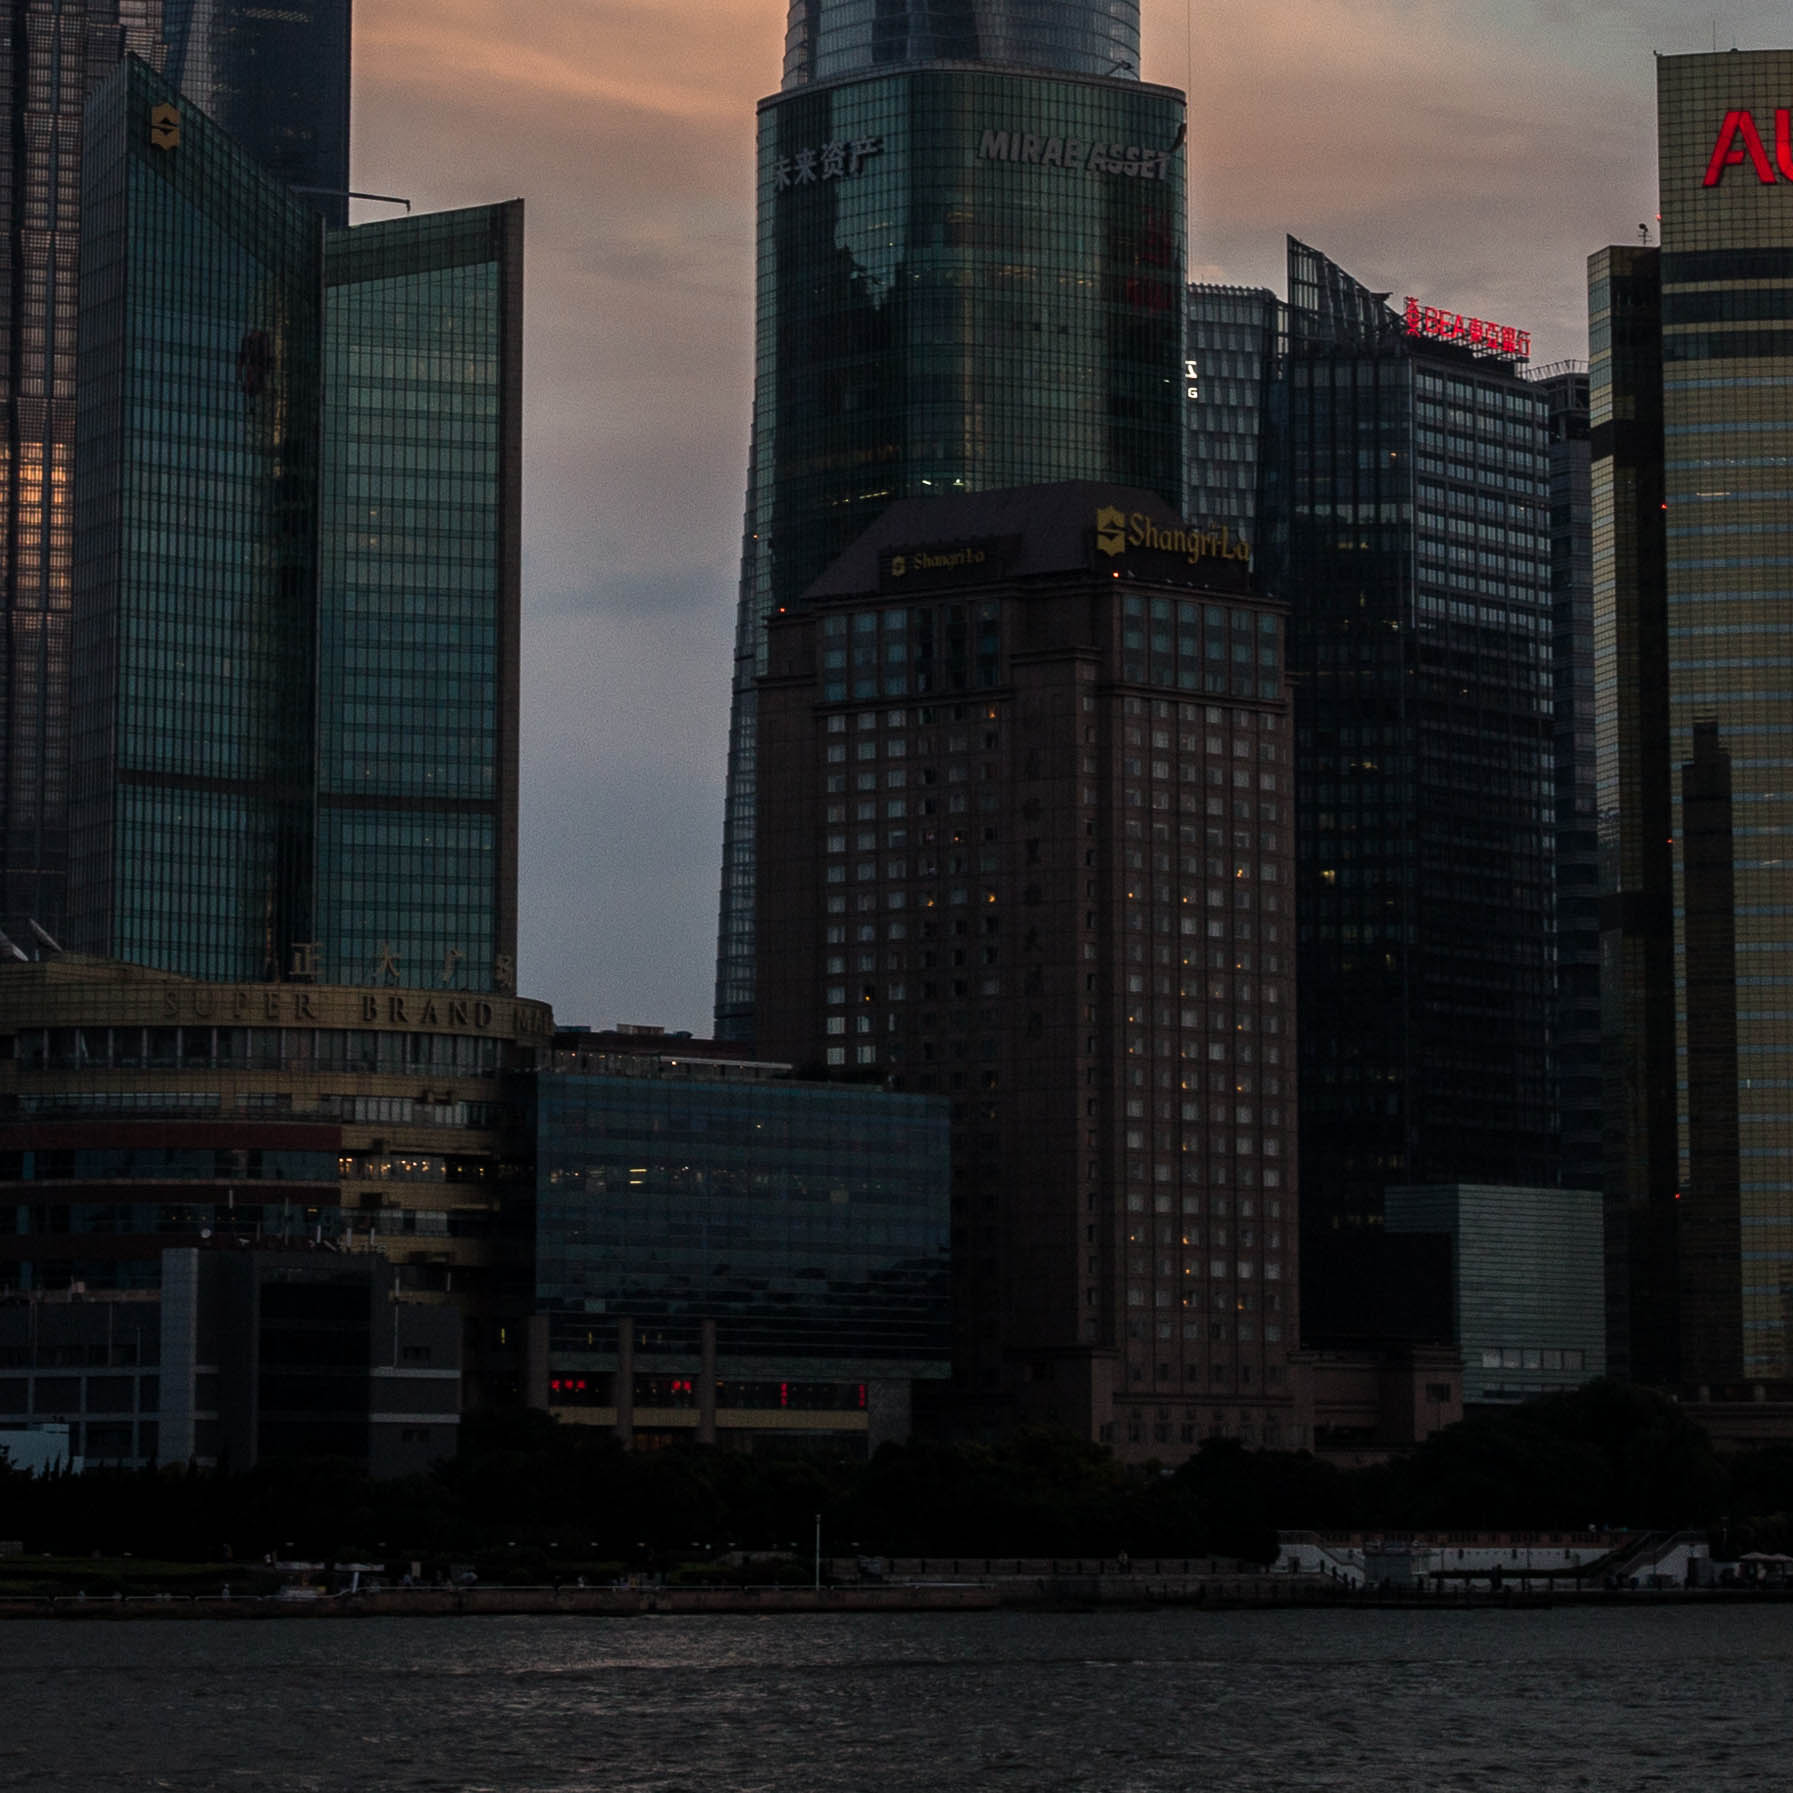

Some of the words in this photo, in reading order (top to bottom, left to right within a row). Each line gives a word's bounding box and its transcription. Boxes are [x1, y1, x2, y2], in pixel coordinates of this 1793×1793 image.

[769, 136, 884, 192] 未来资产
[977, 129, 1082, 170] MIRAE
[1086, 142, 1172, 181] ASSET
[1424, 306, 1466, 340] BEA
[1127, 511, 1250, 565] Shangri-La
[163, 990, 317, 1021] SUPER
[361, 994, 493, 1029] BRAND
